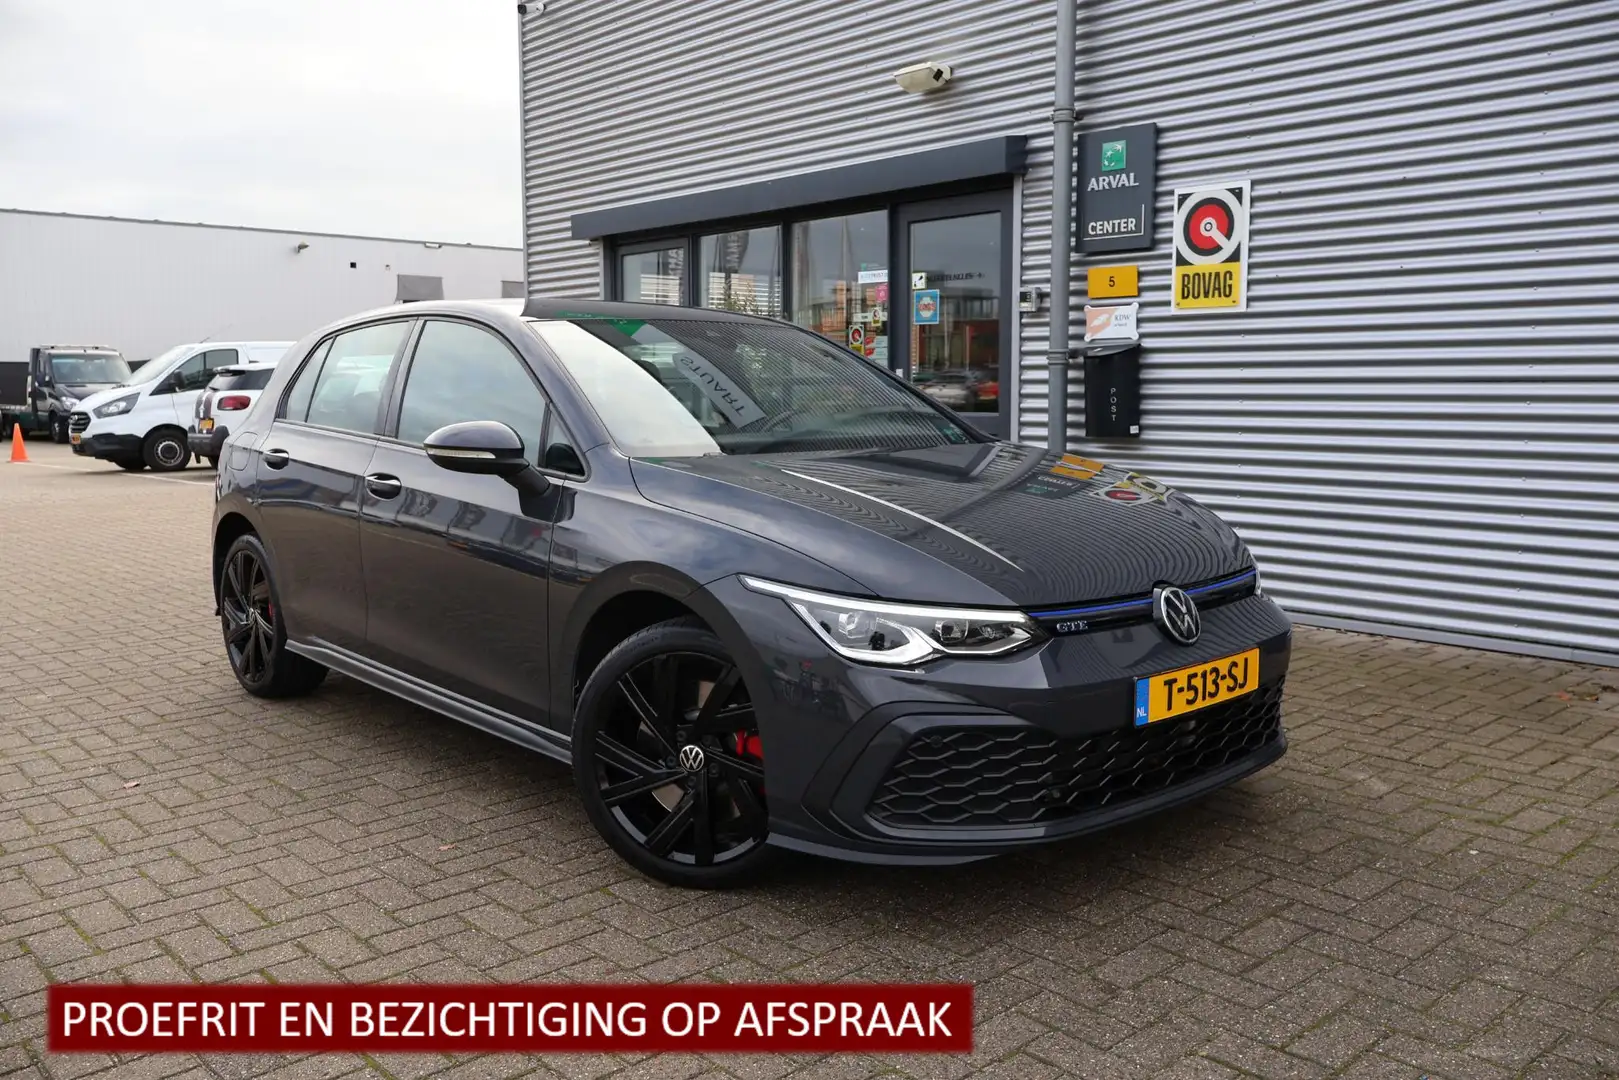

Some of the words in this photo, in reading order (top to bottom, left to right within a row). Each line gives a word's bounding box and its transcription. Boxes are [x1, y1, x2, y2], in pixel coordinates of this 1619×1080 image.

[1087, 172, 1139, 192] ARVAL
[1088, 217, 1137, 236] CENTER
[1108, 275, 1116, 288] 5
[1181, 269, 1234, 300] BOVAG
[1109, 387, 1118, 422] POST
[1056, 620, 1089, 633] GTE
[1163, 657, 1249, 712] T-513-SJ
[1136, 707, 1148, 718] NL
